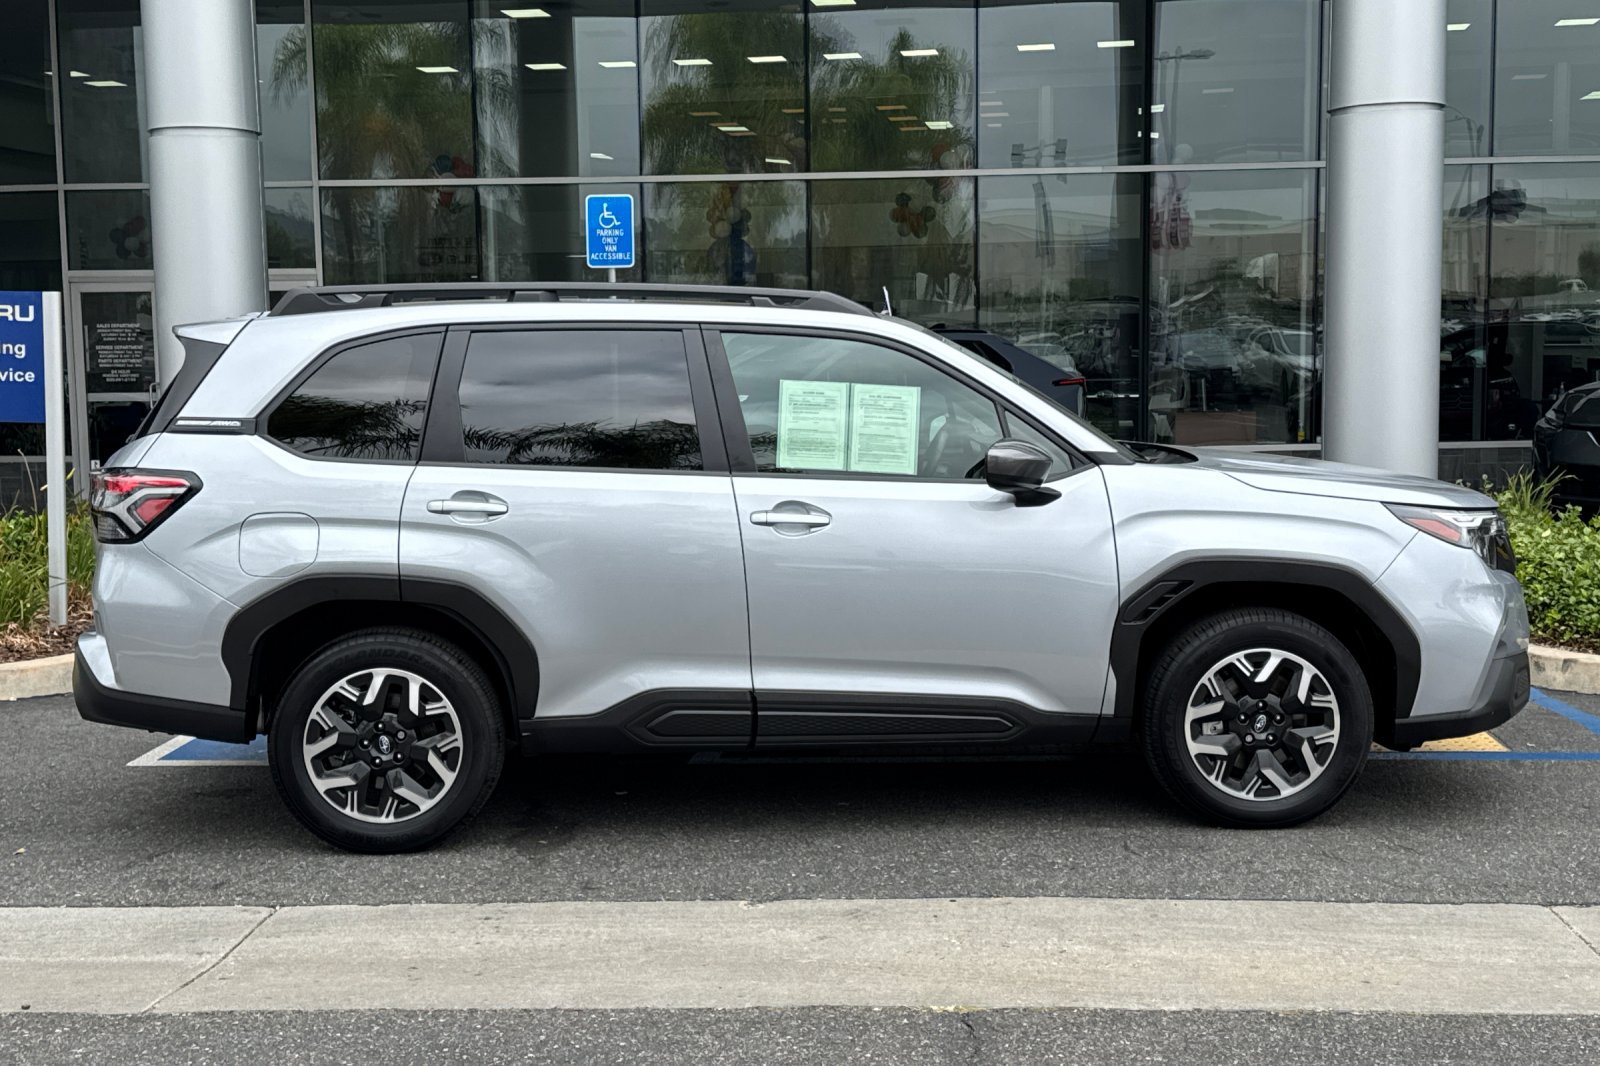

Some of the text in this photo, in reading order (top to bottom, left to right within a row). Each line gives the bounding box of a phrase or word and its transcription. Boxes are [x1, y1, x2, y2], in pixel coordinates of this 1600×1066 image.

[596, 229, 624, 237] PARKING
[604, 244, 617, 252] VAN
[590, 252, 631, 260] ACCESSIBLE
[0, 304, 35, 322] RU
[0, 343, 26, 359] ng
[0, 368, 35, 382] vice
